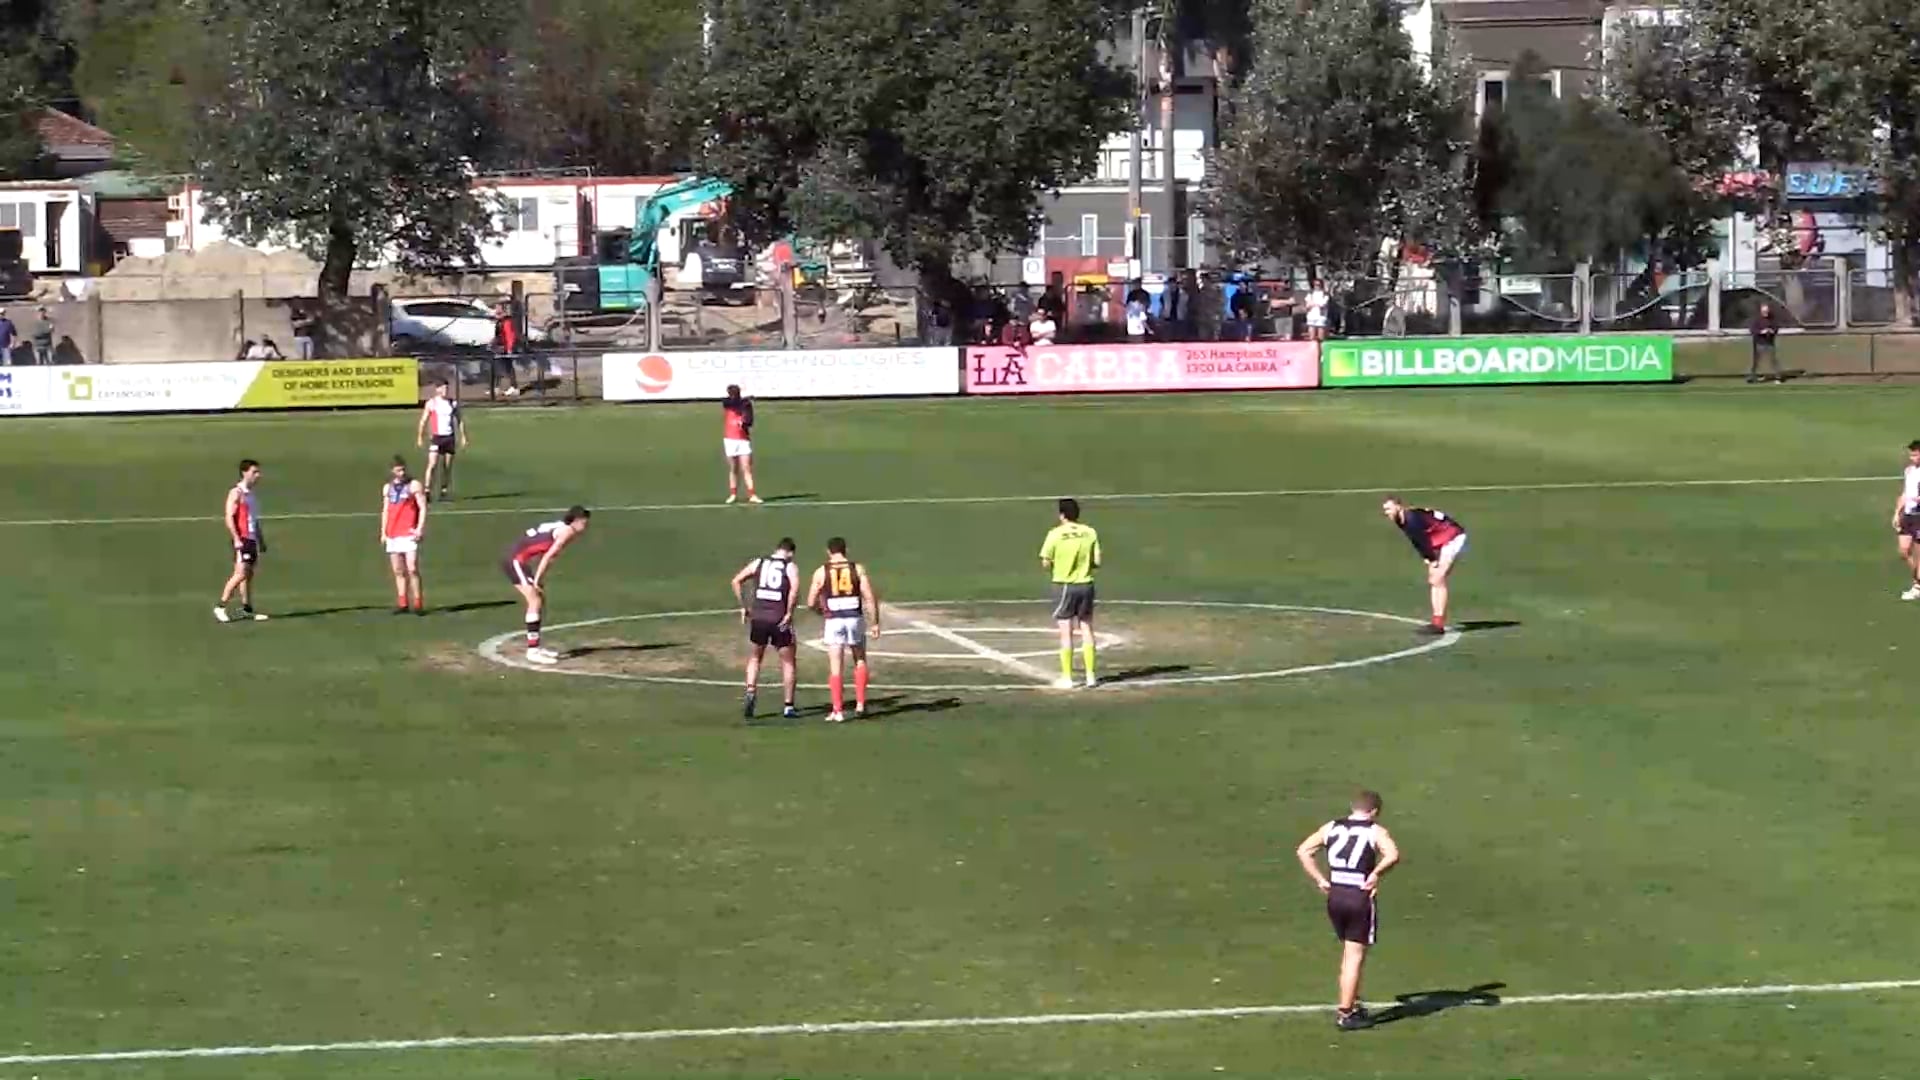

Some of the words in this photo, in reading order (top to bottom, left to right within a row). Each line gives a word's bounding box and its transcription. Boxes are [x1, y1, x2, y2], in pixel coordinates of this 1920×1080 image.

[735, 352, 927, 368] TECHNOLOGIES
[1210, 348, 1263, 362] Hampton
[272, 367, 329, 378] DESIGNERS
[332, 366, 354, 377] AND
[355, 364, 405, 376] BUILDERS
[973, 354, 1027, 386] LA
[1035, 351, 1181, 384] CABRA
[1217, 362, 1234, 373] LA
[284, 380, 297, 390] OF
[300, 379, 330, 390] HOME
[332, 378, 394, 389] EXTENSIONS
[758, 559, 785, 589] 16
[829, 567, 854, 596] 14
[1327, 824, 1371, 869] 27
